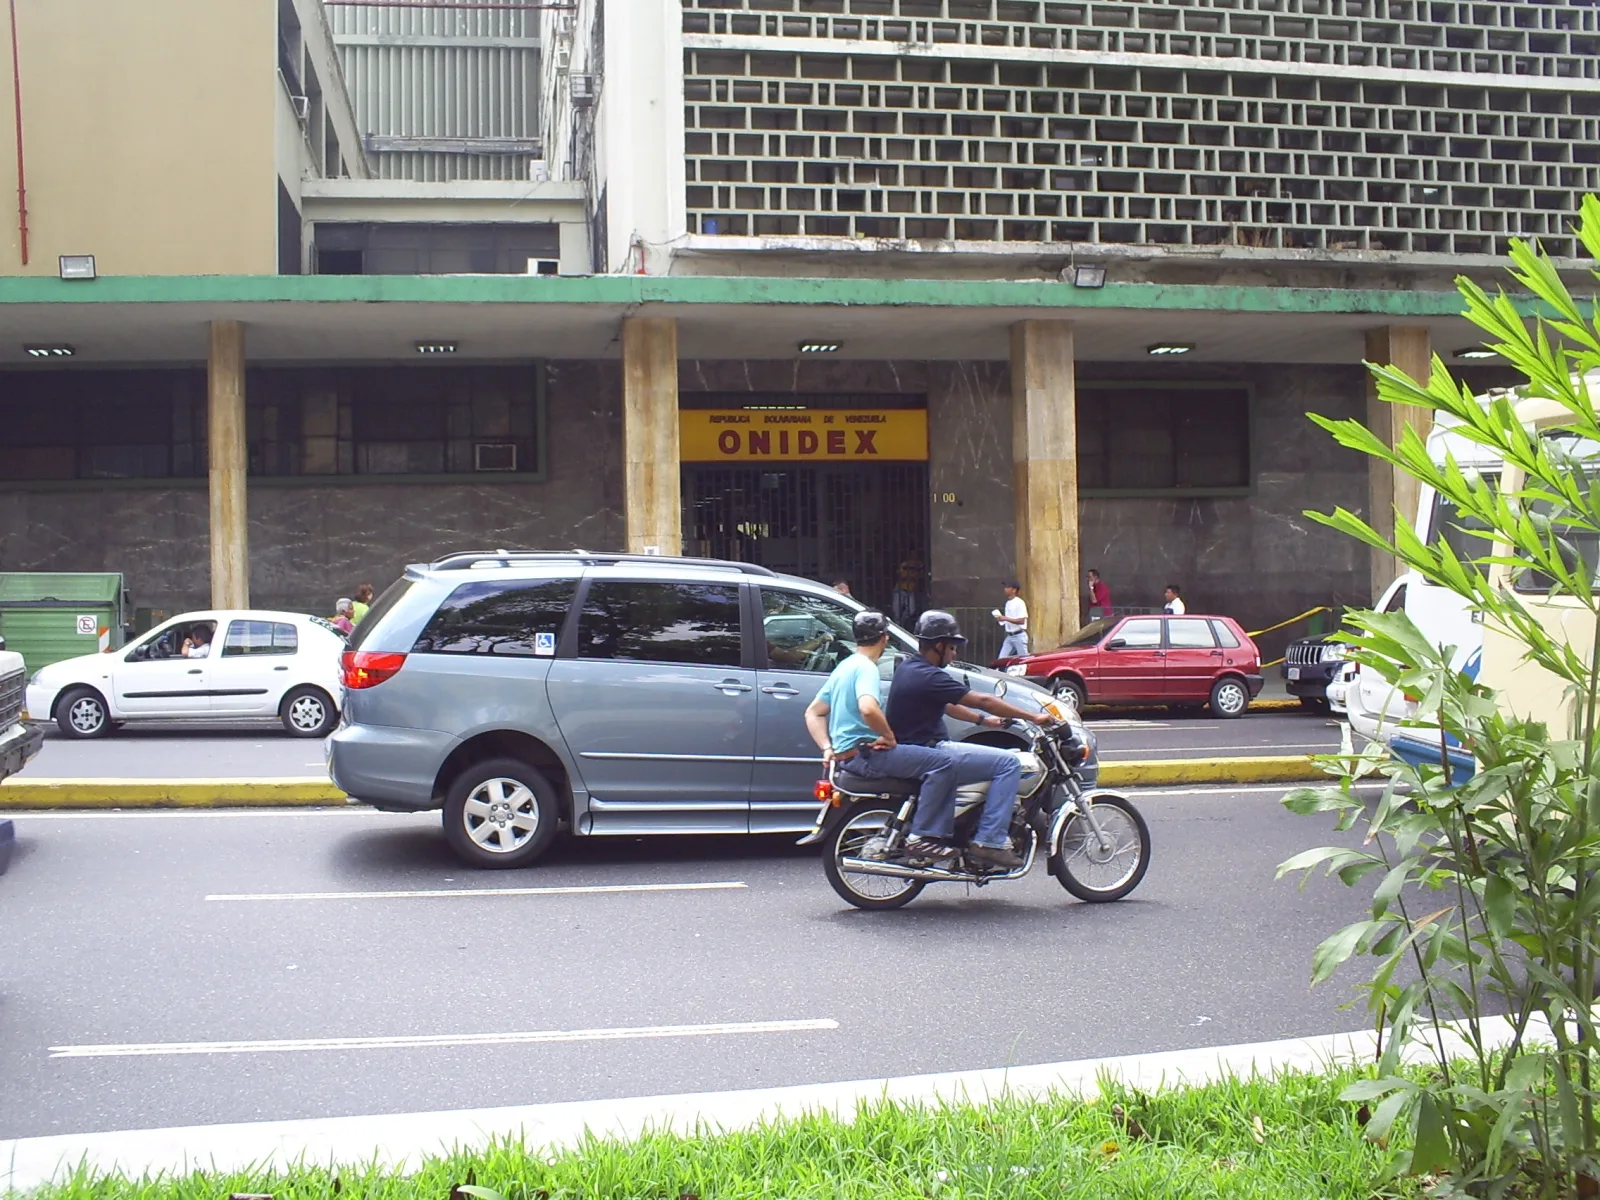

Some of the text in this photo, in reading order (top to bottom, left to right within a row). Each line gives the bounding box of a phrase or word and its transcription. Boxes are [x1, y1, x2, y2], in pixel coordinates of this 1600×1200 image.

[823, 415, 834, 424] DE
[844, 414, 887, 424] VENEZUELA
[718, 429, 878, 455] ONIDEX
